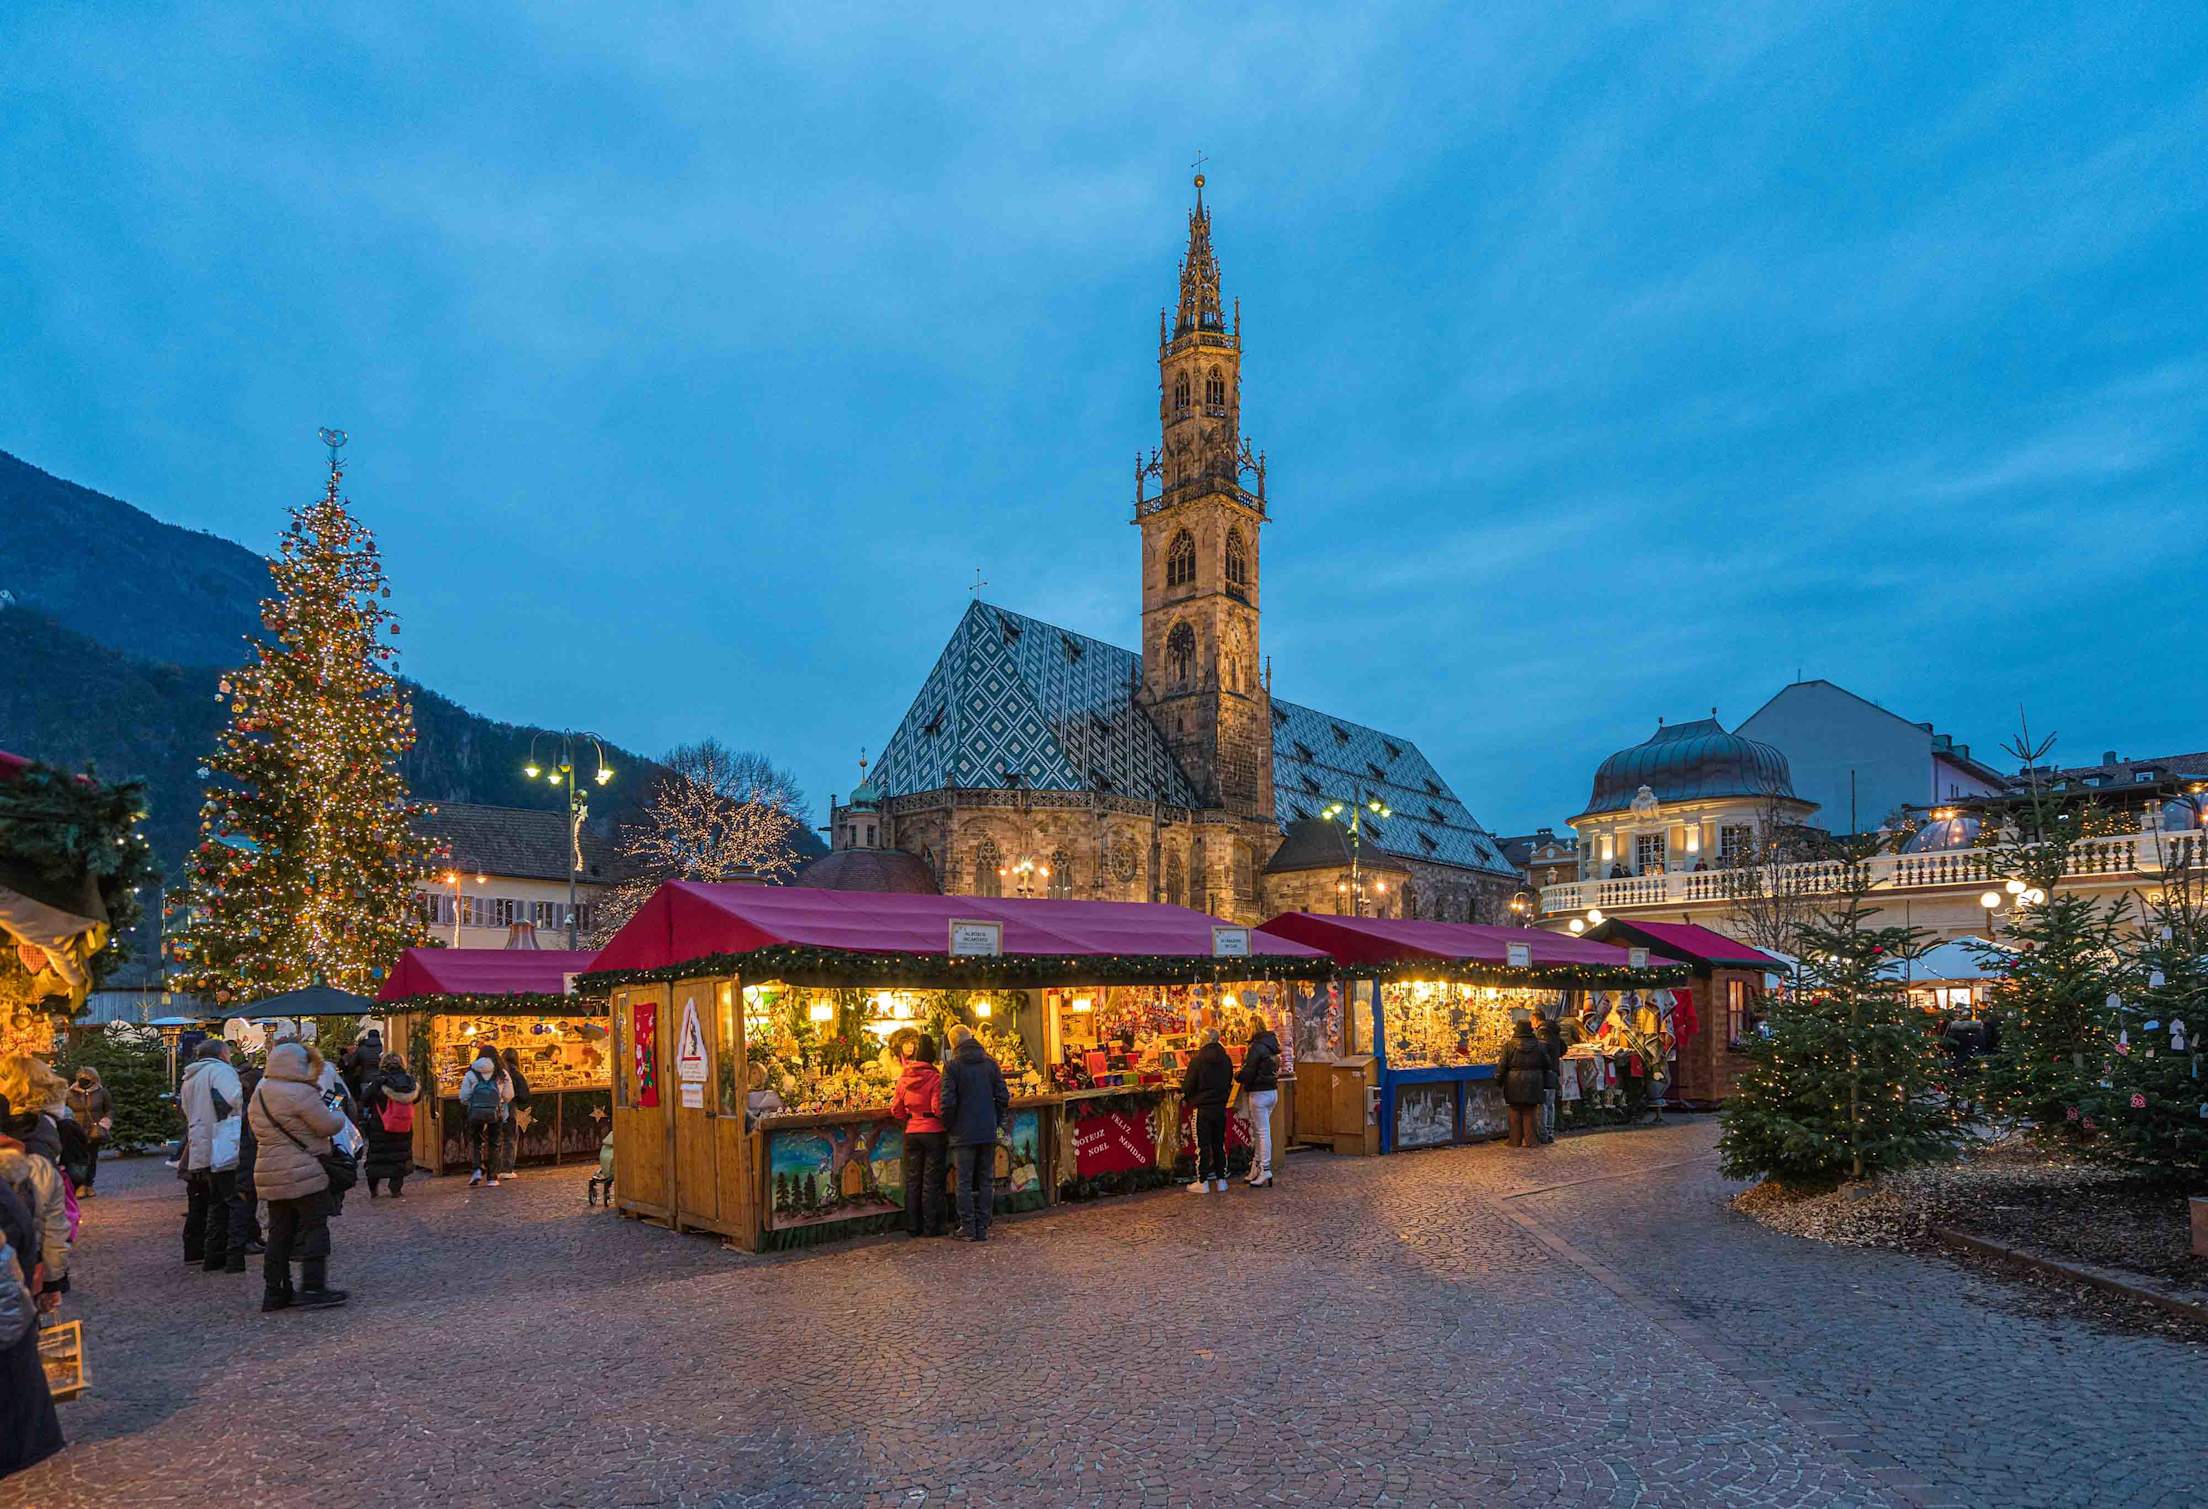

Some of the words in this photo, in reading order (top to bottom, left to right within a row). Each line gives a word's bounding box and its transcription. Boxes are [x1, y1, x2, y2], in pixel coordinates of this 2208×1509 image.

[1111, 1113, 1132, 1135] FELIZ
[1088, 1142, 1109, 1157] NOEL
[1119, 1135, 1146, 1164] NAVIDAD
